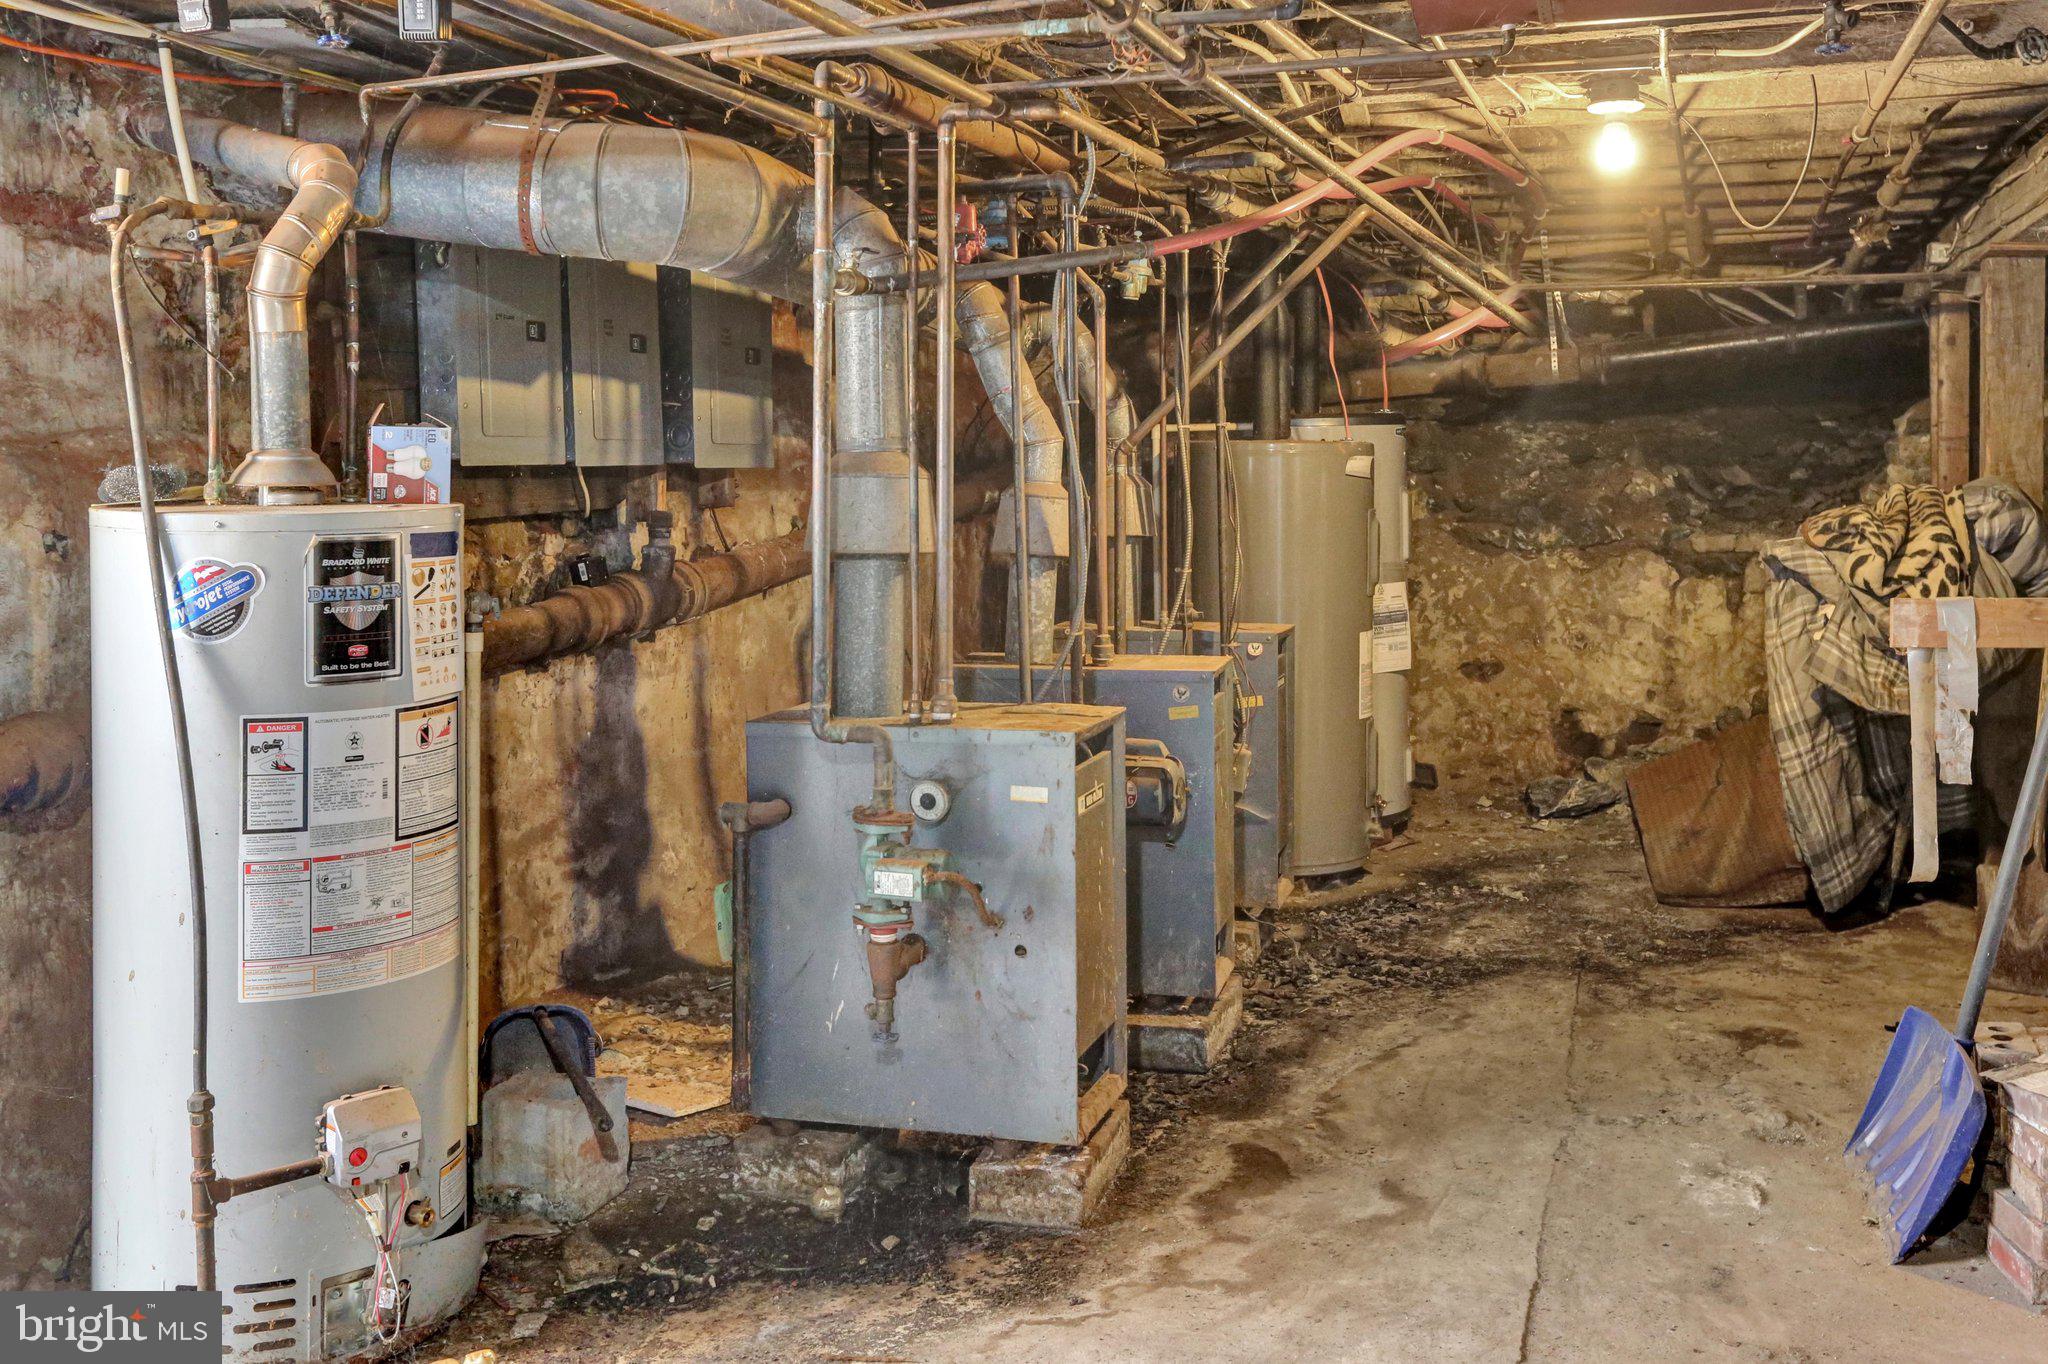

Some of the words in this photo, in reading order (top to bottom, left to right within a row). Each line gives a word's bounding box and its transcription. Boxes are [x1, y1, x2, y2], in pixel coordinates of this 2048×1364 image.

[385, 431, 393, 439] 2
[427, 429, 437, 443] LED
[429, 487, 437, 502] ACE
[322, 558, 365, 567] BRADFORD
[366, 557, 391, 565] WHITE
[307, 582, 402, 603] DEFENDER
[323, 606, 355, 615] SAFETY
[357, 604, 389, 613] SYSTEM
[340, 663, 348, 671] to
[350, 662, 359, 670] be
[361, 661, 373, 669] the
[374, 660, 390, 668] Best
[427, 707, 445, 716] WARNING
